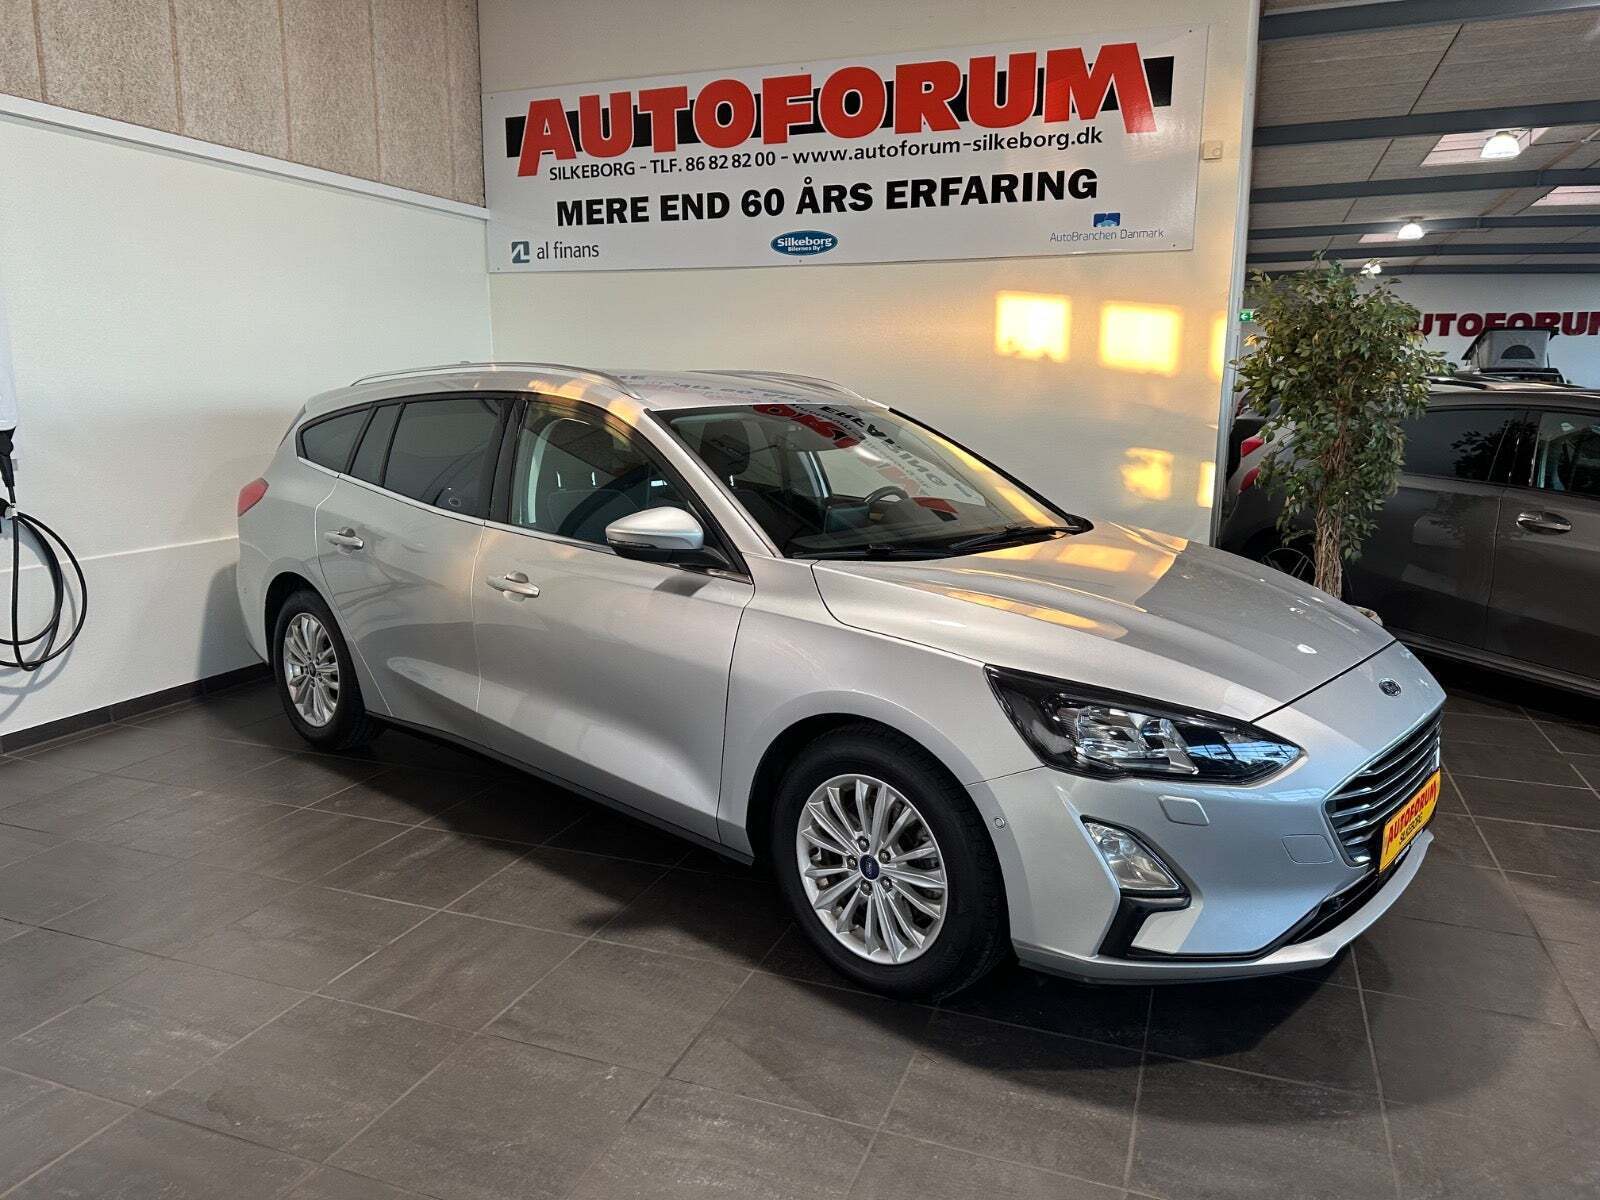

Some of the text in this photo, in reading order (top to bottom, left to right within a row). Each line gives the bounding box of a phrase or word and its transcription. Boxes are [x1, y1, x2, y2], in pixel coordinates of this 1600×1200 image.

[517, 42, 1157, 177] AUTOFORUM
[549, 161, 636, 181] SILKEBORG
[650, 159, 683, 174] TLF.
[685, 156, 706, 172] 86
[708, 155, 728, 170] 82
[731, 153, 752, 169] 82
[754, 151, 776, 167] 00
[792, 126, 1103, 164] www.autoforum-silkeborg.dk
[556, 168, 1099, 227] MERE END 60 ÅRS ERFARING
[536, 240, 600, 259] al finans
[777, 236, 833, 247] Silkeborg
[1050, 227, 1165, 242] AutoBranchen Danmark
[1386, 780, 1437, 854] AUTOFORUM
